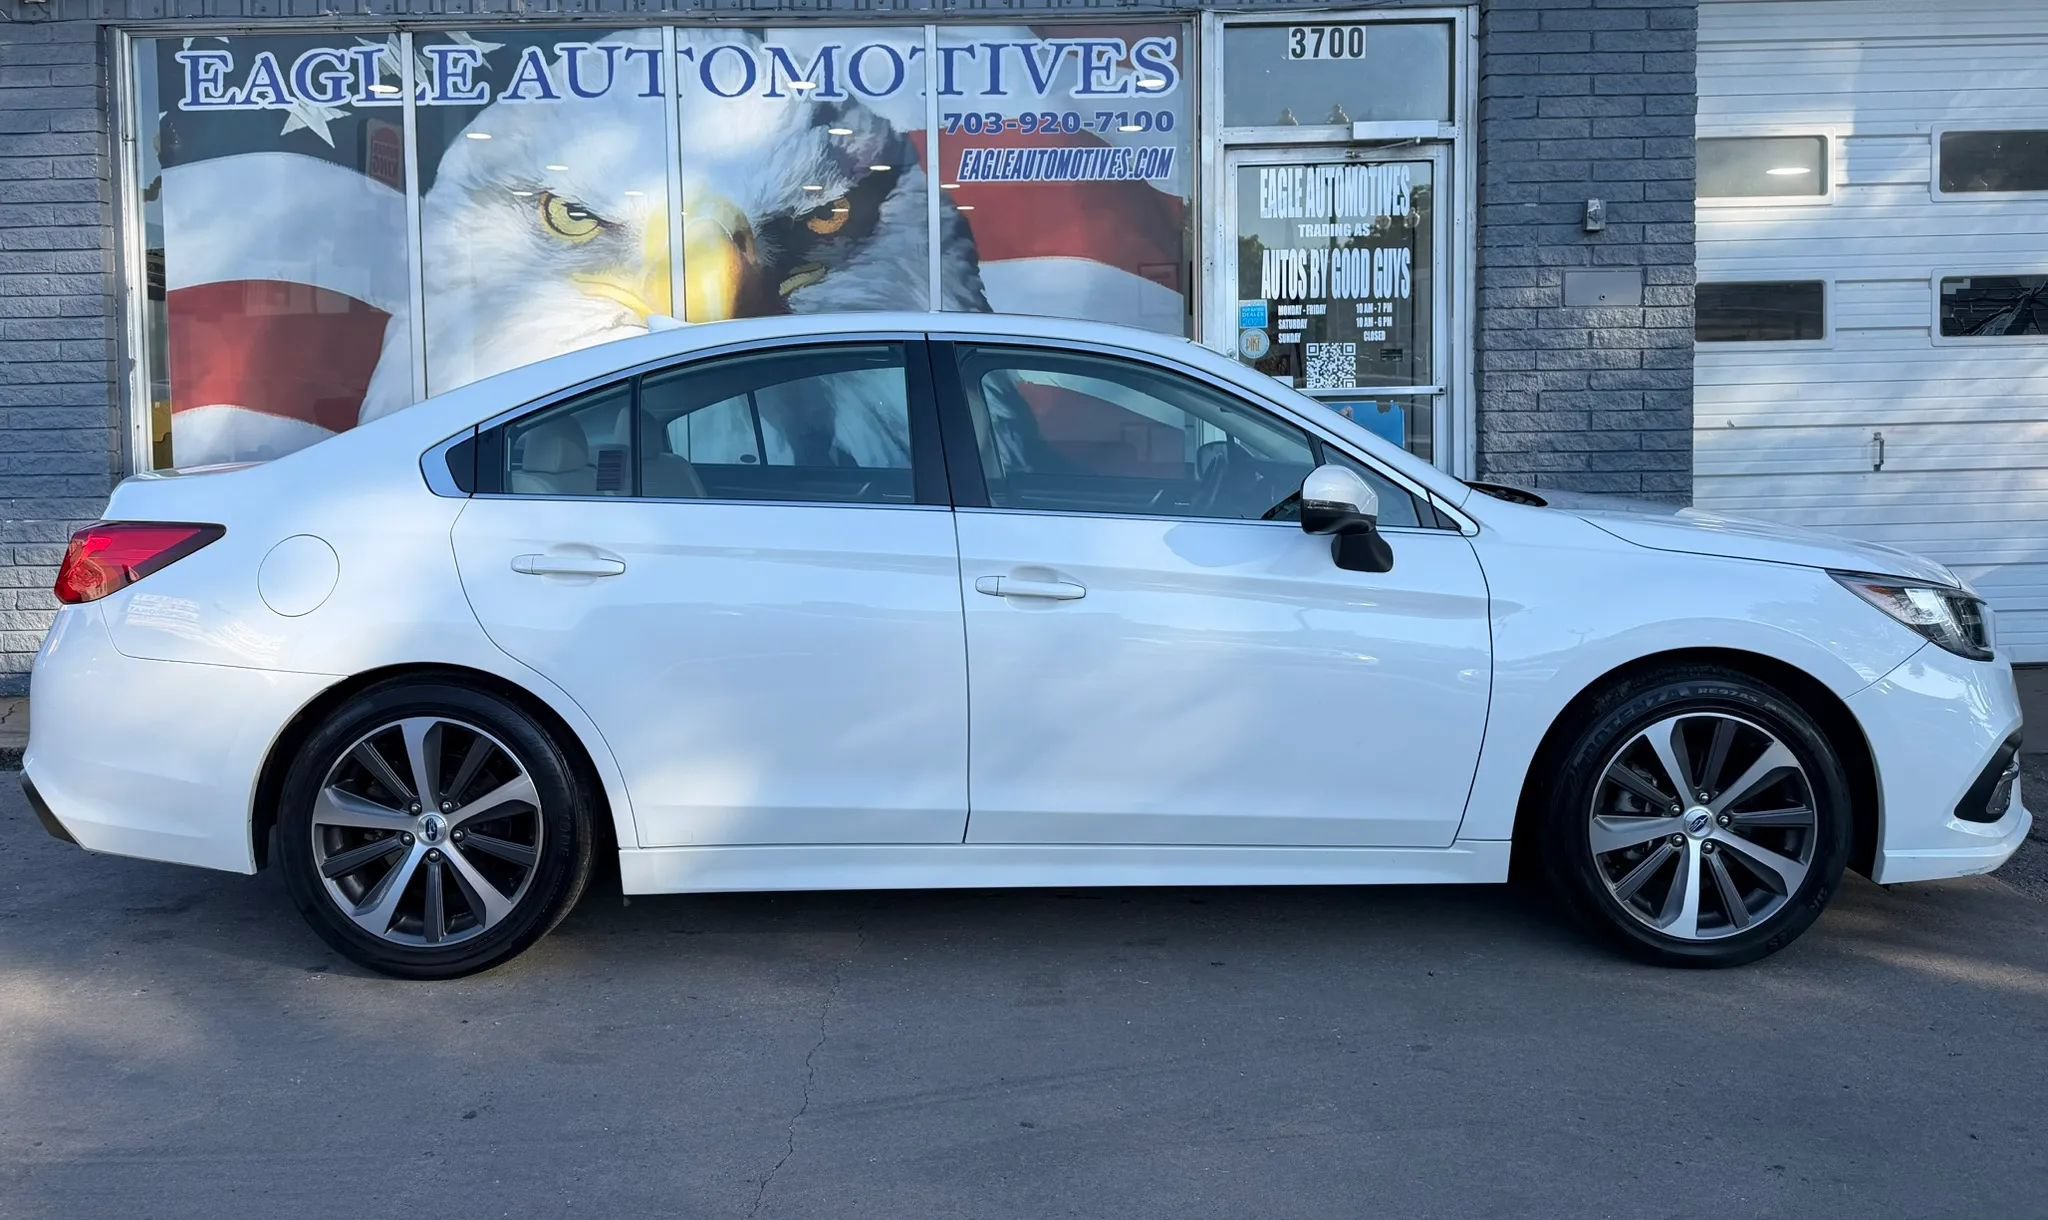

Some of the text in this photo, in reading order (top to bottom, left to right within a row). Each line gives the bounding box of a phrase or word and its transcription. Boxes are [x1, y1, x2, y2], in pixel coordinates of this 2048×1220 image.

[1290, 27, 1364, 58] 3700
[178, 38, 1177, 110] EAGLE AUTOMOTIVES
[944, 111, 1175, 134] 703-920-7100
[957, 147, 1175, 181] EAGLEAUTOMOTIVES.COM
[1260, 165, 1411, 219] EAGLE AUTOMOTIVES
[1298, 224, 1370, 238] TRADING AS
[1261, 247, 1411, 300] AUTOS BY GOOD GUYS
[1277, 304, 1302, 316] MONDAY
[1306, 303, 1327, 315] FRIDAY
[1356, 302, 1364, 314] 10
[1364, 302, 1374, 314] AM
[1382, 302, 1393, 313] PM
[1278, 318, 1308, 330] SATURDAY
[1356, 316, 1364, 328] 10
[1364, 316, 1374, 327] AM
[1382, 316, 1393, 327] PM
[1278, 332, 1301, 344] SUNDAY
[1363, 330, 1386, 341] CLOSED
